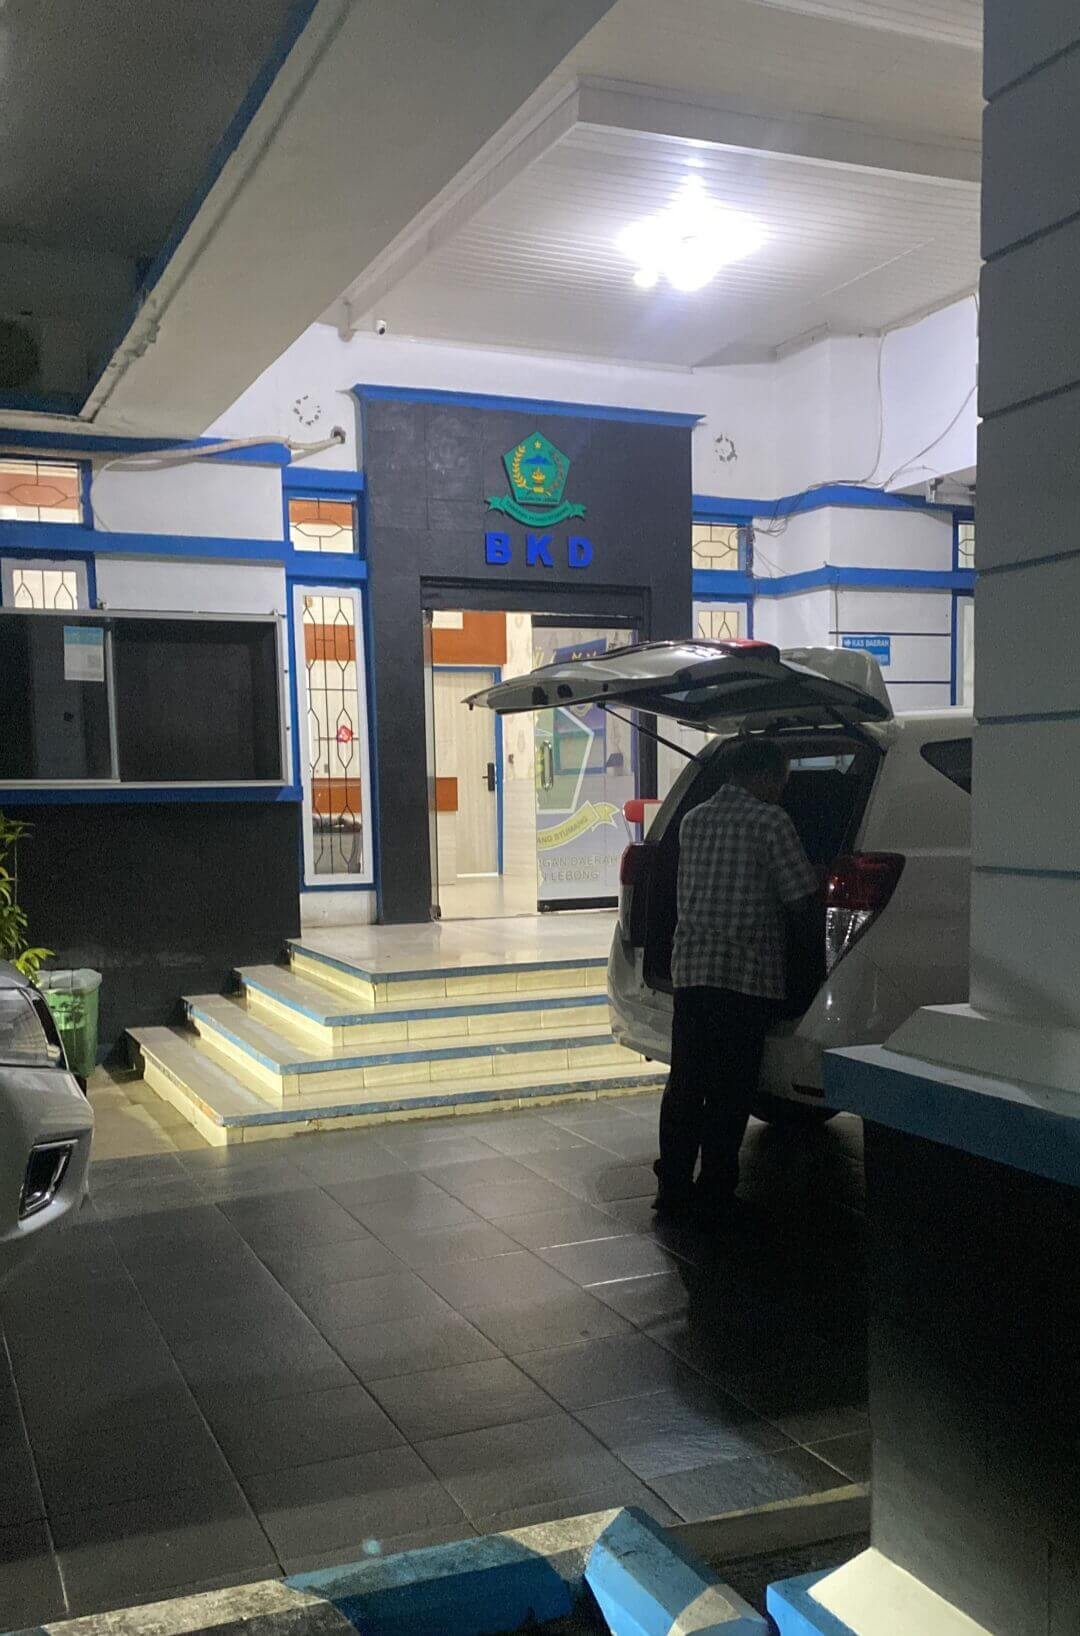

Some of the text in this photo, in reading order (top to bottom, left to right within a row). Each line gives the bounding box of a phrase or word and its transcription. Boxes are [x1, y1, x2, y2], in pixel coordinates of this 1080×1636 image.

[485, 531, 594, 569] BKD
[865, 639, 889, 648] DAERAH
[551, 871, 600, 881] LEBONG
